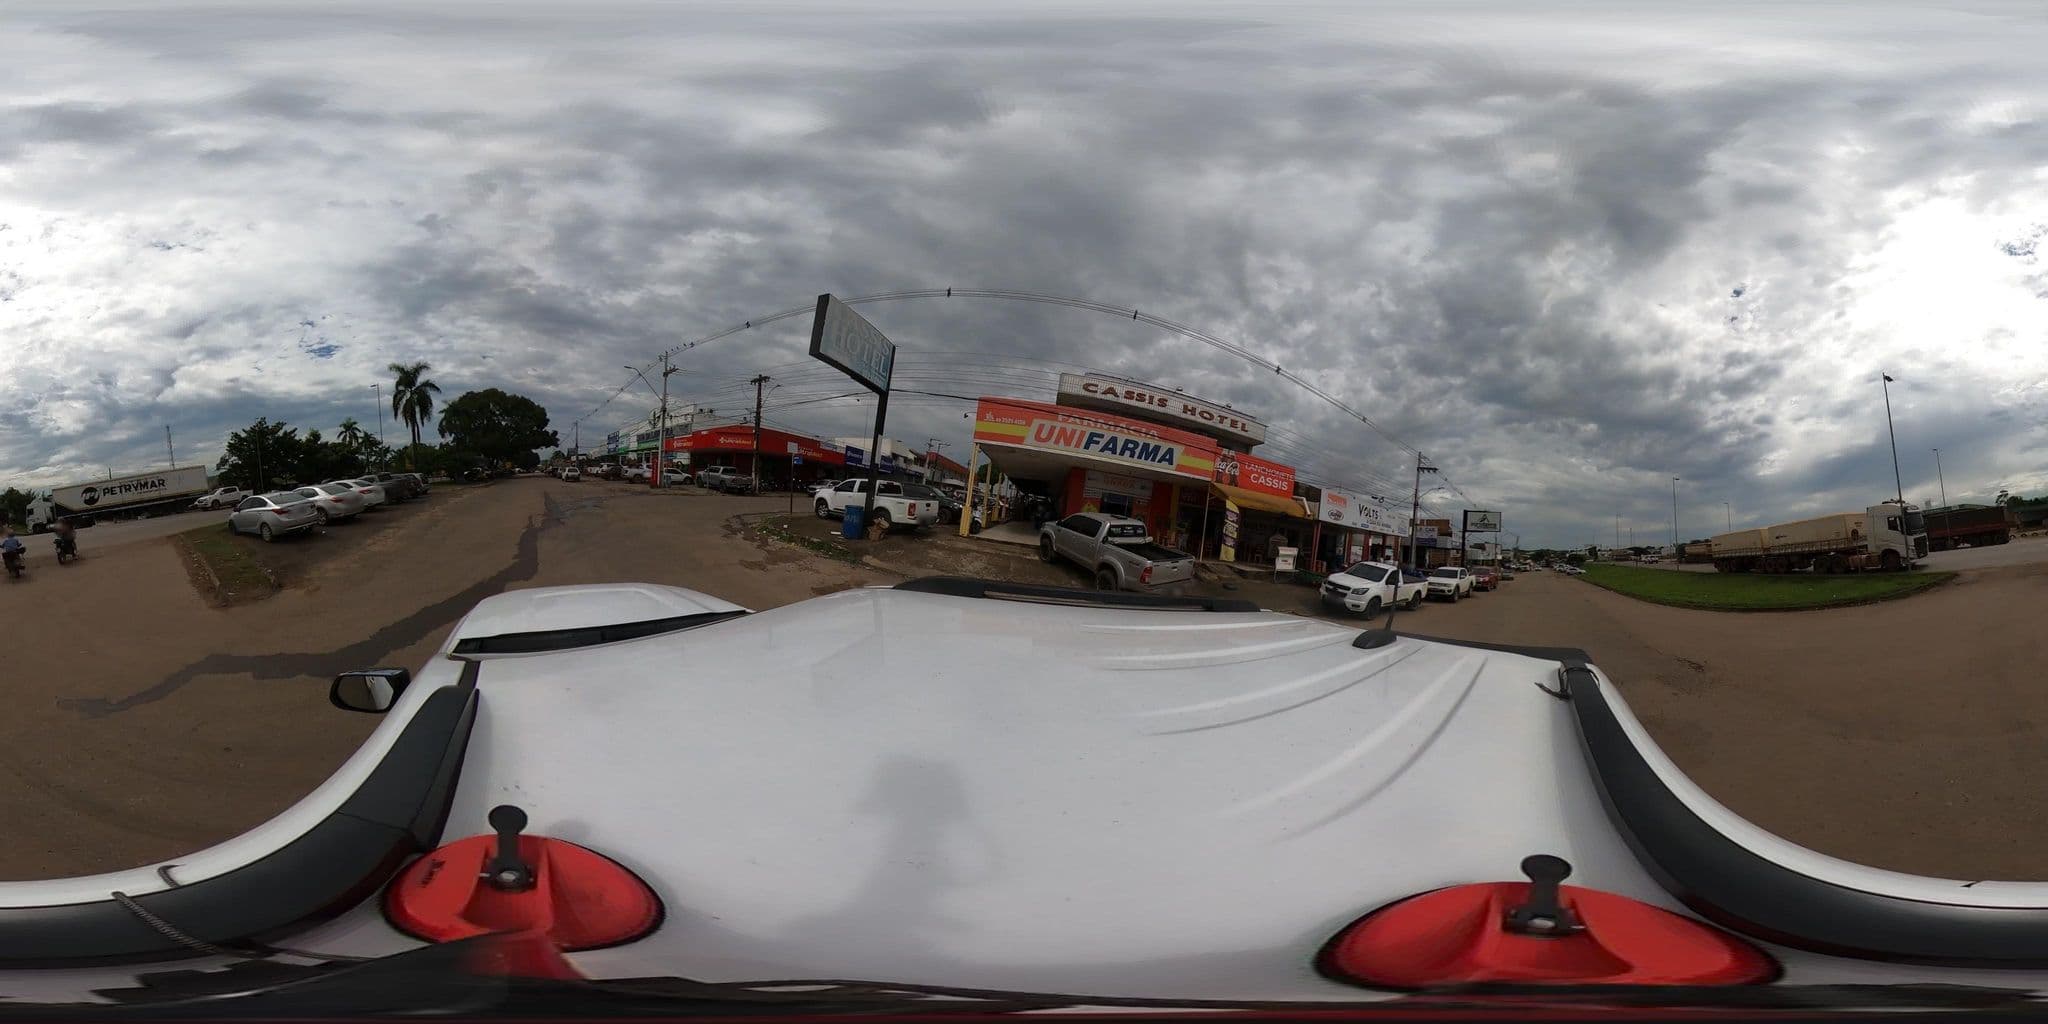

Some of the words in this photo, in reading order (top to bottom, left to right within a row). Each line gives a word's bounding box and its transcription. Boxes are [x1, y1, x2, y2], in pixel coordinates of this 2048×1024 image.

[1082, 382, 1168, 408] CASSIS
[1182, 404, 1249, 433] HOTEL
[1034, 423, 1174, 466] UNIFARMA
[102, 479, 166, 497] PETRYMAR
[1250, 473, 1289, 491] CASSIS
[1358, 503, 1379, 520] VOLTS
